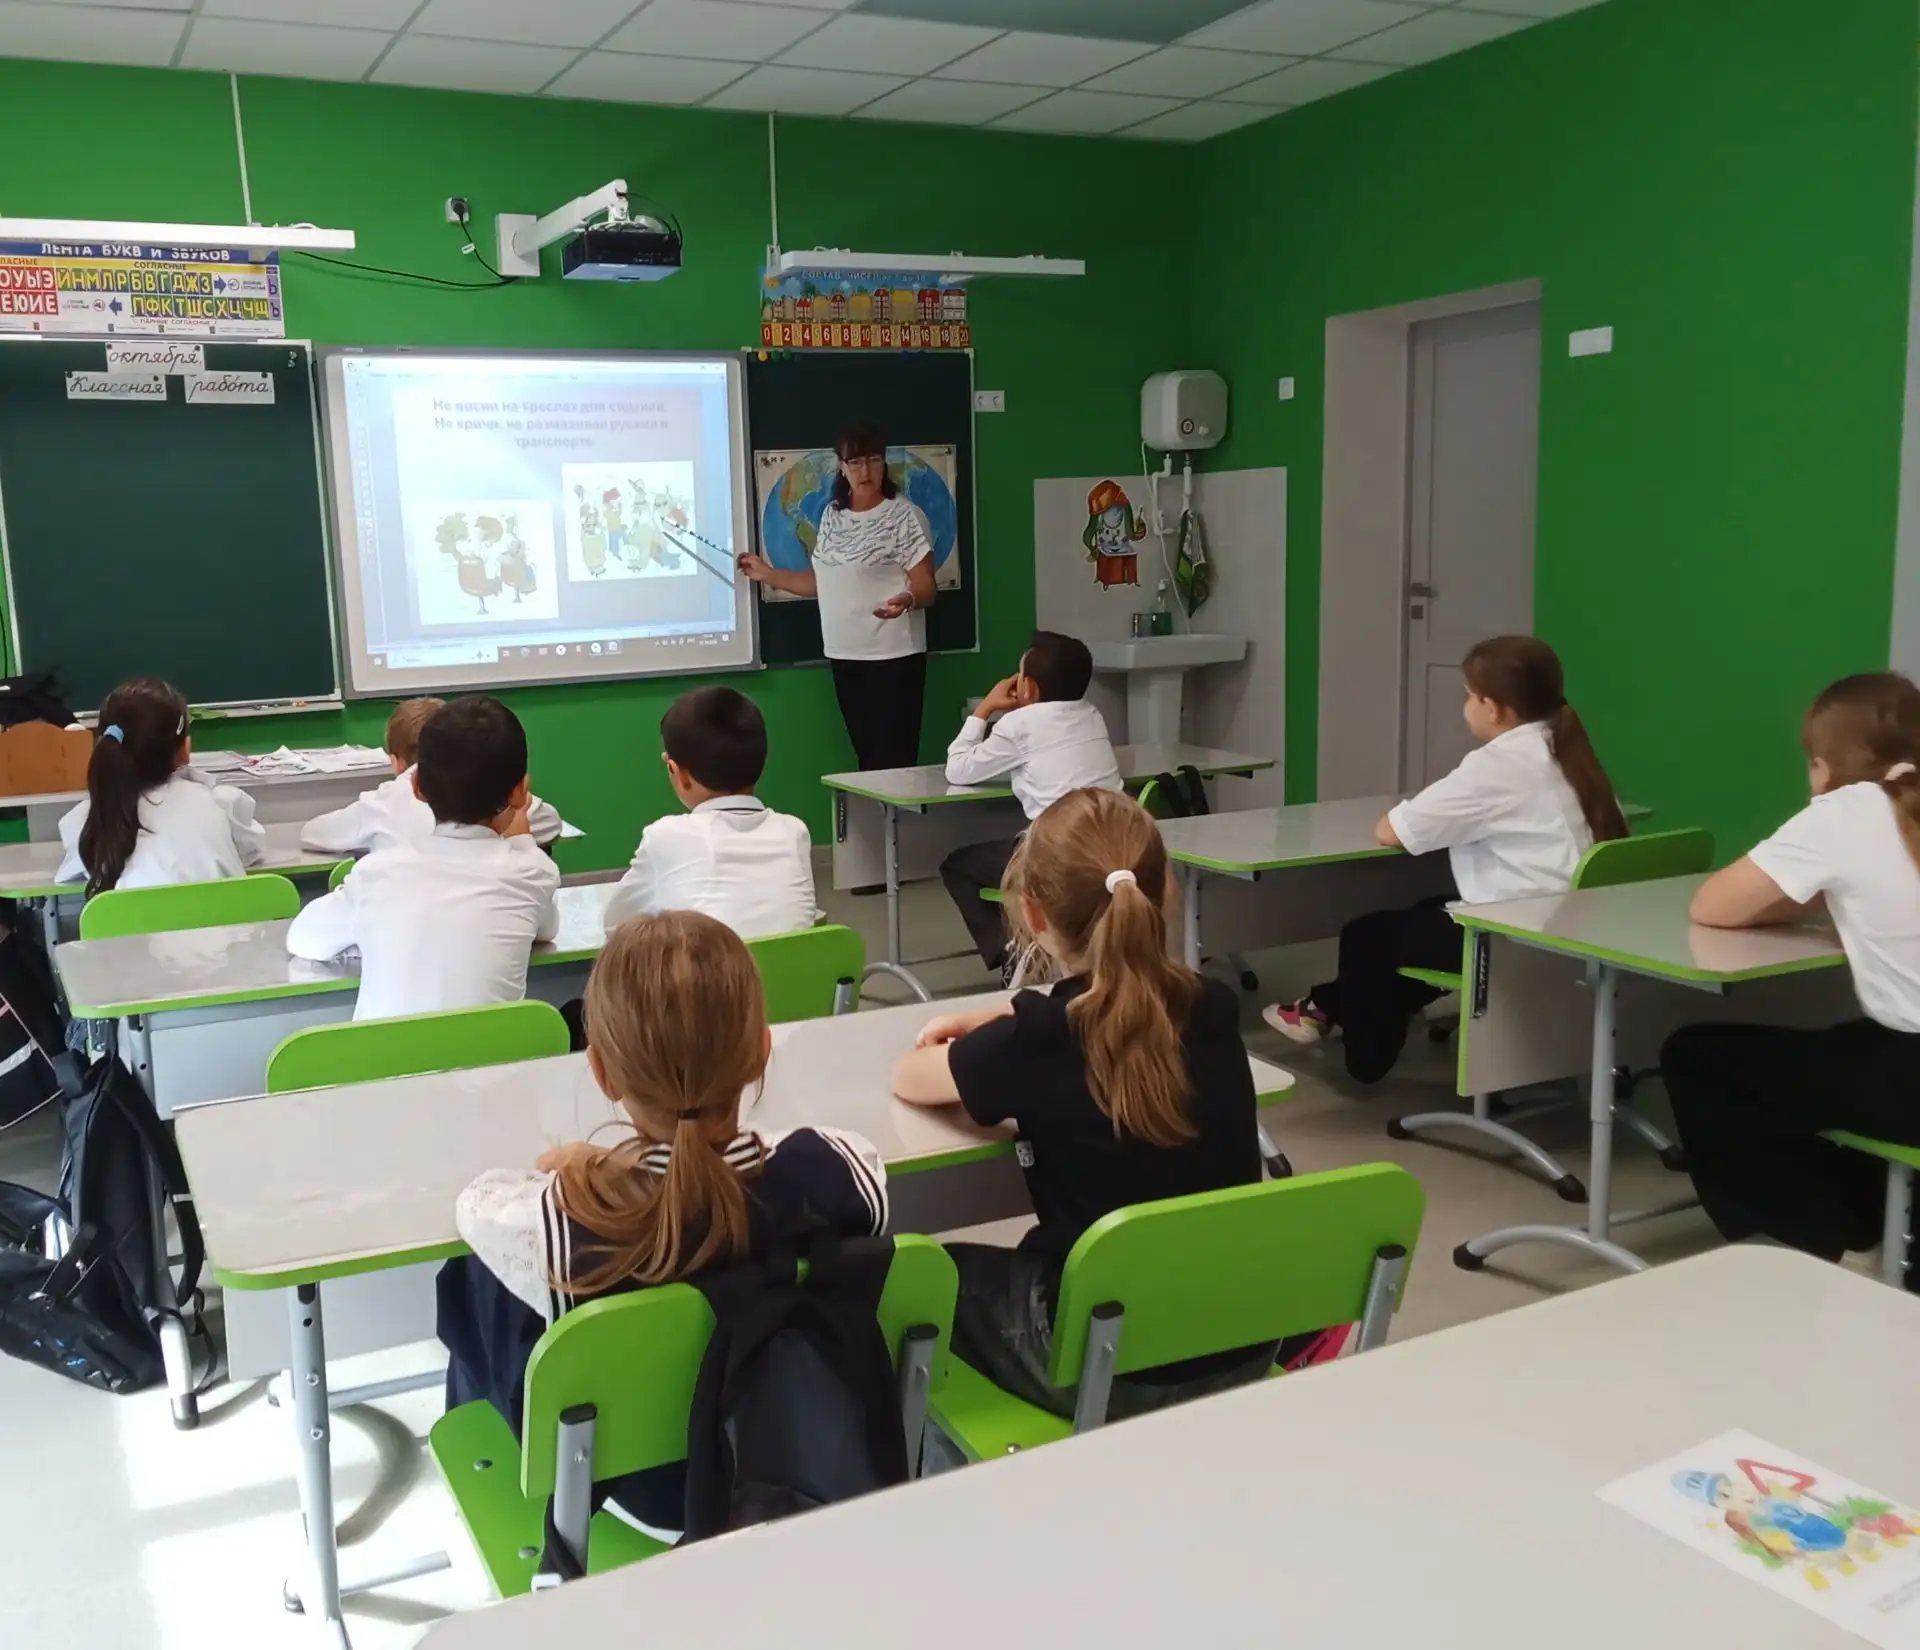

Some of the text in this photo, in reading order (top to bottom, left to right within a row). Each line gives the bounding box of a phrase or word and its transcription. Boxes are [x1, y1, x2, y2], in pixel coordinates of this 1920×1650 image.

[41, 242, 231, 261] ЛЕНТА БУКВ И ЗВУКОВ
[134, 261, 187, 271] СОГЛАСНЫЕ
[764, 327, 771, 341] 0
[783, 327, 791, 341] 2
[803, 327, 811, 341] 4
[823, 327, 830, 341] 6
[843, 327, 850, 342] 8
[861, 328, 870, 342] 10
[881, 328, 890, 342] 12
[901, 328, 910, 342] 14
[921, 328, 930, 342] 16
[941, 328, 950, 342] 18
[69, 376, 165, 394] Классная
[433, 398, 452, 412] Не
[434, 416, 453, 429] Не
